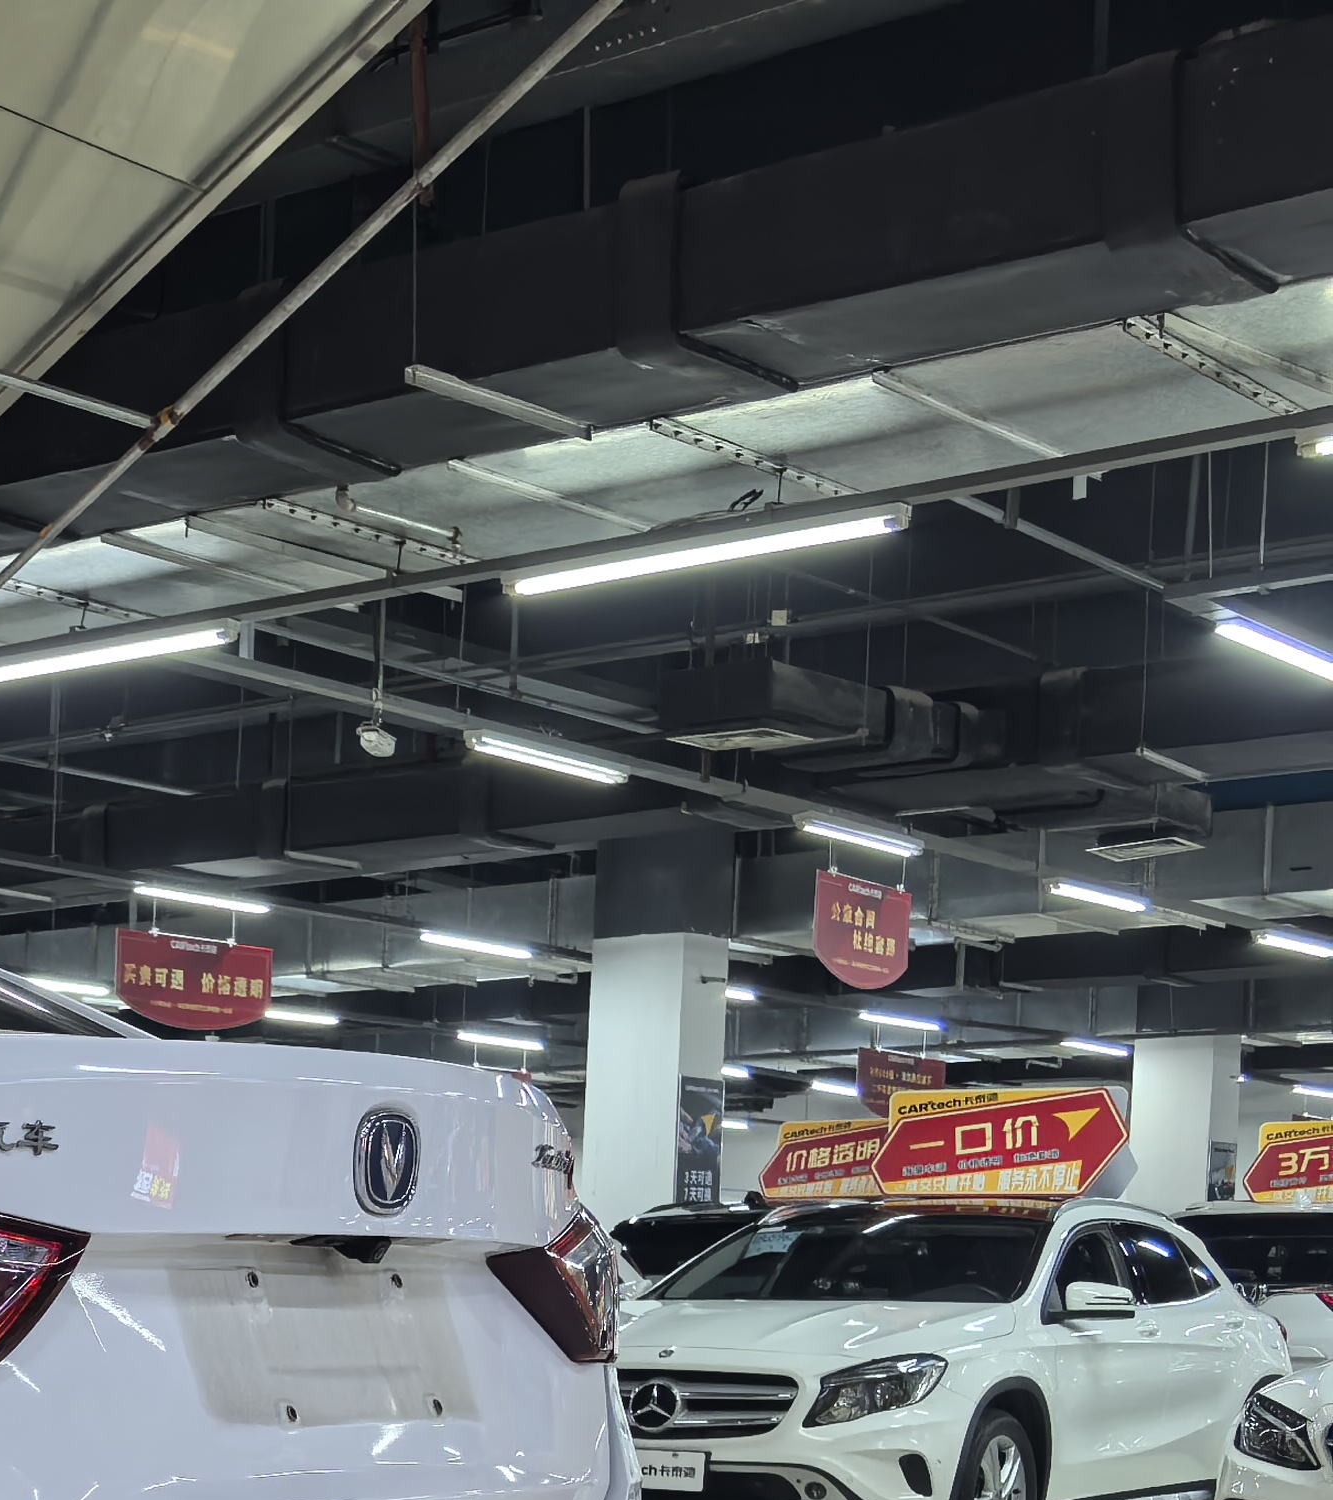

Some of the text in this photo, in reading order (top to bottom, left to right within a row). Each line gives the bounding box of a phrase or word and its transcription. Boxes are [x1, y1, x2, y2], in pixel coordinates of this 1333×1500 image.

[897, 1099, 961, 1115] CARtech
[909, 1115, 1040, 1156] 一口价
[786, 1138, 881, 1173] 价格透明
[1278, 1146, 1333, 1176] 3万
